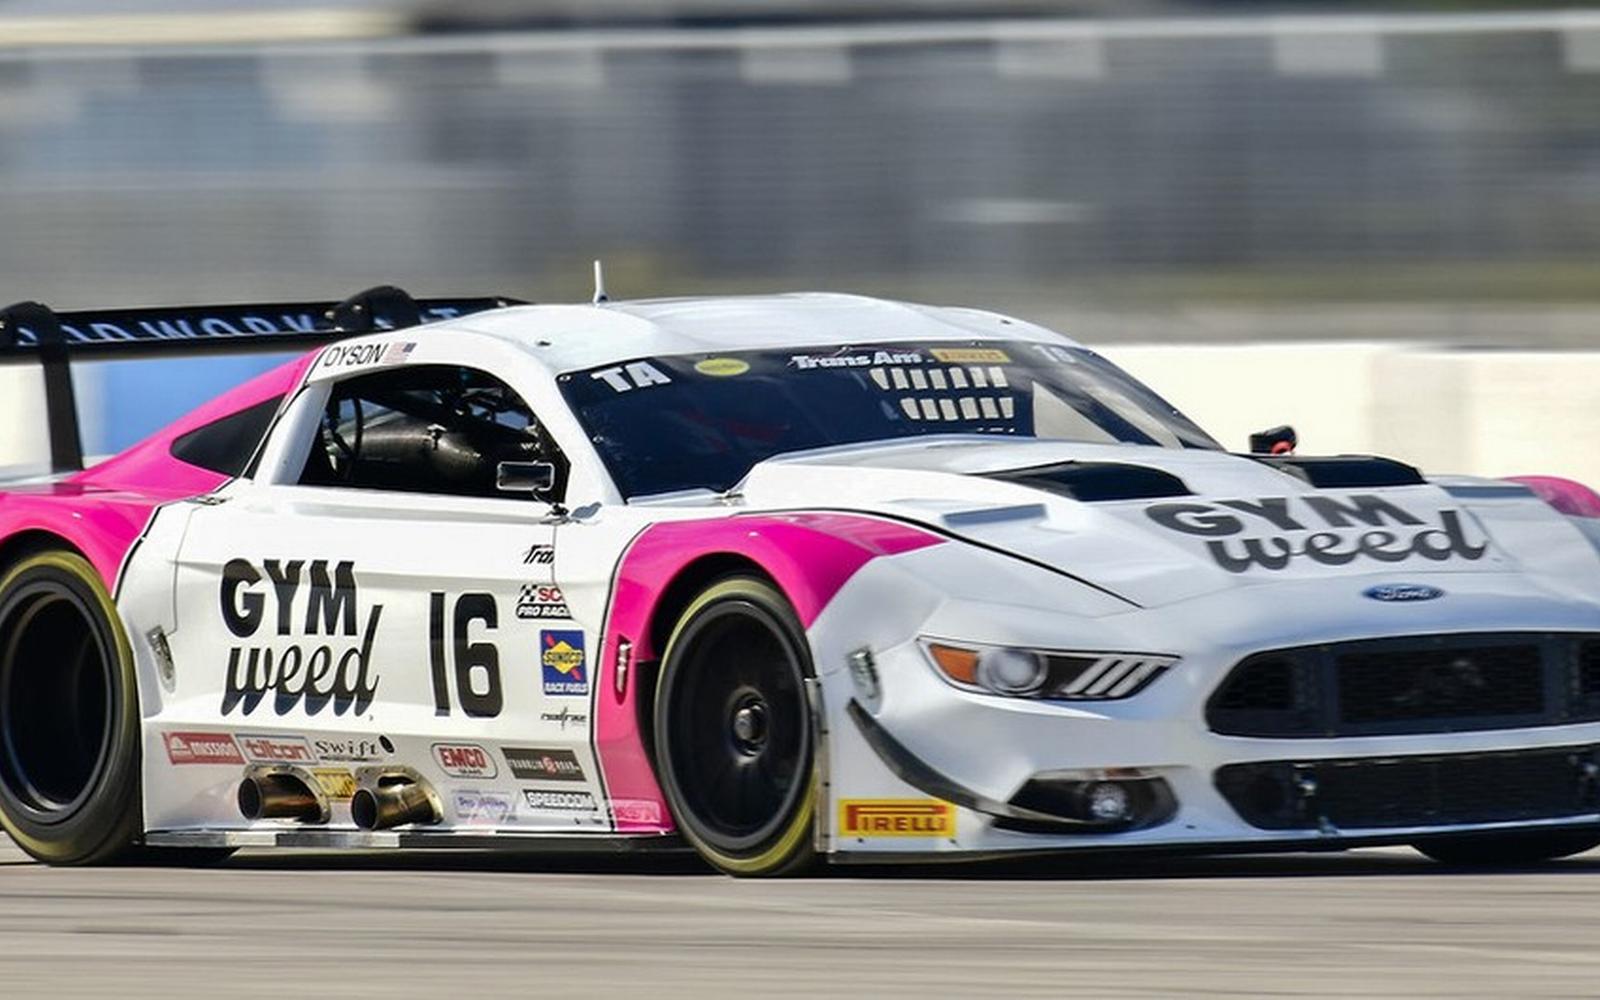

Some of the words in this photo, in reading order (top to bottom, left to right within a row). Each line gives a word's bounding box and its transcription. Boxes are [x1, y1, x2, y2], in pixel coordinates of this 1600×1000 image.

[323, 343, 389, 367] DYSON
[791, 354, 871, 370] Trans
[873, 351, 922, 366] Am
[590, 360, 672, 393] TA
[1145, 495, 1428, 537] GYM
[1207, 510, 1489, 574] weed
[220, 557, 357, 638] GYM
[517, 605, 541, 617] PRO
[220, 604, 384, 718] weed
[429, 592, 503, 718] 16
[543, 651, 583, 664] SUNOCO
[315, 740, 379, 756] Swift
[438, 747, 488, 768] EMCO
[527, 792, 594, 809] SPEEDCOM
[846, 804, 947, 832] PIRELLI
